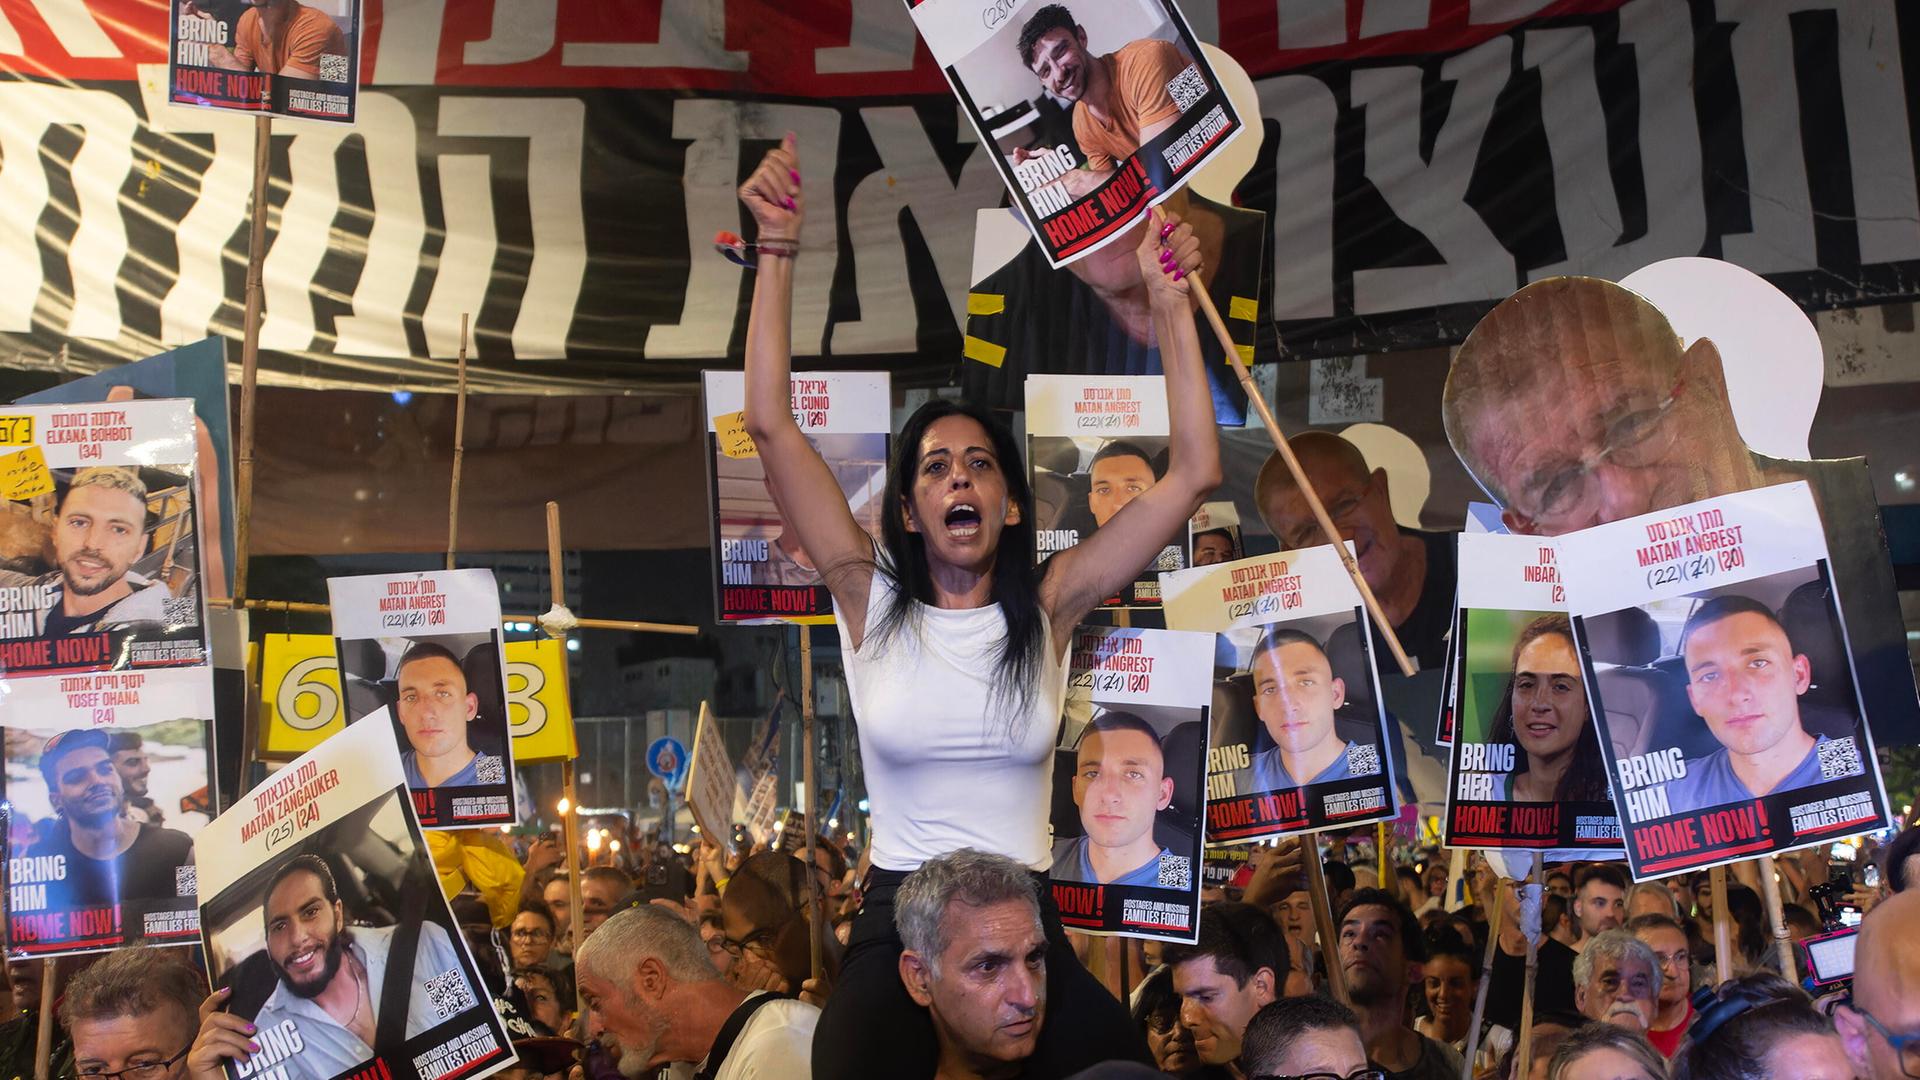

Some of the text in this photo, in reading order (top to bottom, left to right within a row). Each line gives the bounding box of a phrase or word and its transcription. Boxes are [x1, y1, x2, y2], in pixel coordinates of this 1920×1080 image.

[178, 15, 228, 44] BRING
[177, 40, 209, 68] HIM
[176, 68, 222, 96] HOME
[289, 98, 349, 115] FAMILIES FORUM
[1167, 112, 1230, 173] FAMILIES FORUM
[1014, 144, 1077, 193] BRING
[1028, 180, 1074, 220] HIM
[1043, 155, 1152, 248] HOME NOW!
[799, 380, 828, 394] אריאל
[802, 396, 830, 410] CUNIO
[1074, 401, 1142, 414] MATAN ANGREST
[46, 427, 132, 444] ELKANA BOHBOT
[79, 444, 102, 460] (34)
[1037, 529, 1079, 550] BRING
[1646, 509, 1724, 543] מתן אנגרסט
[721, 539, 768, 562] BRING
[1636, 526, 1744, 568] MATAN ANGREST
[722, 563, 752, 585] HIM
[1271, 560, 1289, 578] מתן
[1524, 566, 1554, 584] INBAR
[0, 584, 55, 612] BRING
[420, 580, 436, 594] מתן
[724, 586, 816, 612] HOME NOW!
[1222, 576, 1302, 603] MATAN ANGREST
[379, 594, 446, 612] MATAN ANGREST
[0, 612, 34, 639] HIM
[0, 633, 110, 669] HOME NOW!
[1122, 638, 1142, 655] מתן
[1104, 655, 1155, 674] ANGREST
[95, 676, 118, 690] חיים
[121, 674, 145, 689] יוסף
[277, 656, 340, 732] 6
[66, 690, 140, 709] YOSEF OHANA
[92, 708, 115, 724] (24)
[1460, 743, 1516, 772] BRING
[1616, 747, 1688, 791] BRING
[298, 760, 318, 788] מתן
[1206, 773, 1237, 800] HIM
[1457, 774, 1494, 801] HER
[241, 768, 340, 844] MATAN ZANGAUKER
[453, 802, 510, 816] FAMILIES FORUM
[1207, 786, 1308, 830] HOME NOW!
[1324, 794, 1387, 816] FAMILIES FORUM
[1624, 785, 1672, 824] HIM
[1792, 801, 1878, 834] FAMILIES FORUM
[1454, 805, 1507, 834] HOME
[1510, 803, 1559, 836] NOW!
[1575, 825, 1612, 839] FAMILIES
[1633, 816, 1700, 861] HOME
[1702, 800, 1771, 847] NOW!
[265, 819, 294, 851] (25)
[10, 854, 67, 885] BRING
[10, 884, 48, 912] HIM
[12, 903, 123, 943] HOME NOW!
[144, 918, 200, 934] FAMILIES FOR
[1122, 908, 1190, 928] FAMILIES FORUM
[412, 1043, 448, 1070] HOSTAGES
[446, 1036, 462, 1054] AND
[417, 1051, 464, 1080] FAMILIES
[461, 1033, 499, 1064] FORUM
